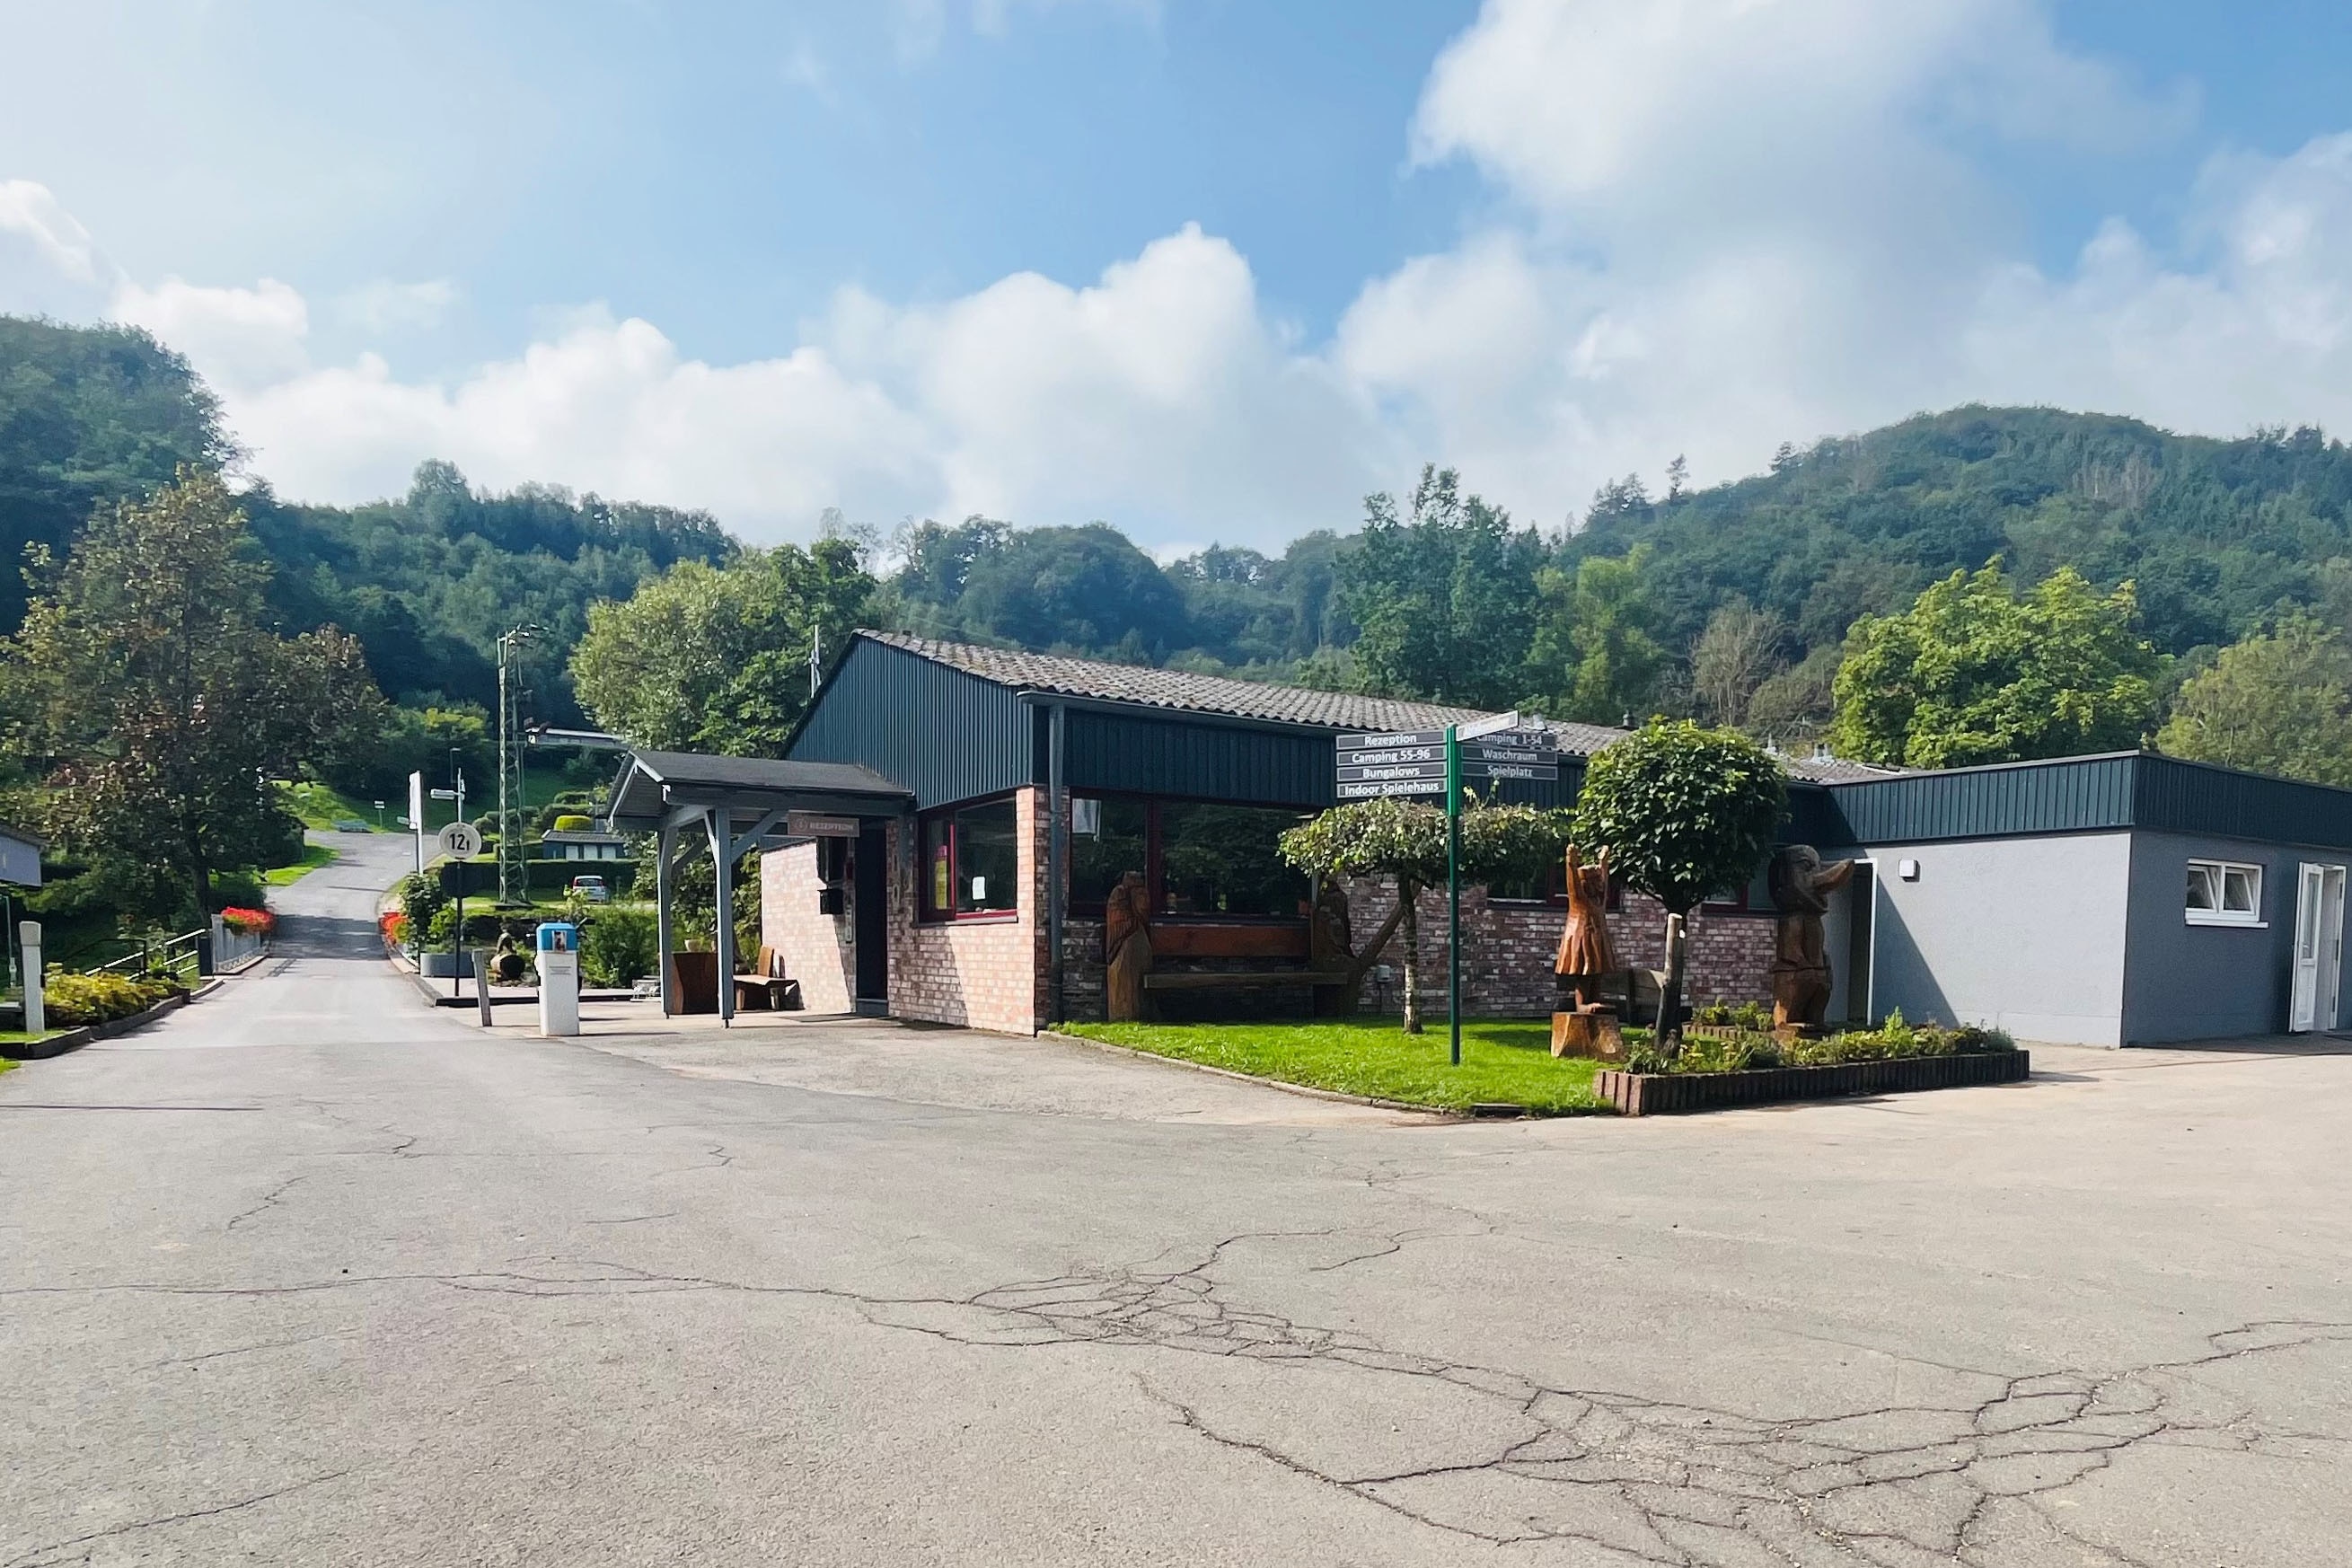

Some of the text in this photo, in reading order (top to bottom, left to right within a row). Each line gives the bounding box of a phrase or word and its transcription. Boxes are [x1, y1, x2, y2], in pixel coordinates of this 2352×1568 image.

[1364, 734, 1417, 746] Rezeption
[1522, 735, 1543, 744] 1-54
[1352, 749, 1431, 763] Camping 55-96
[1482, 748, 1537, 761] Waschraum
[1362, 766, 1421, 780] Bungalows
[1487, 764, 1533, 778] Spielplatz
[1344, 781, 1440, 797] Indoor Spielehaus
